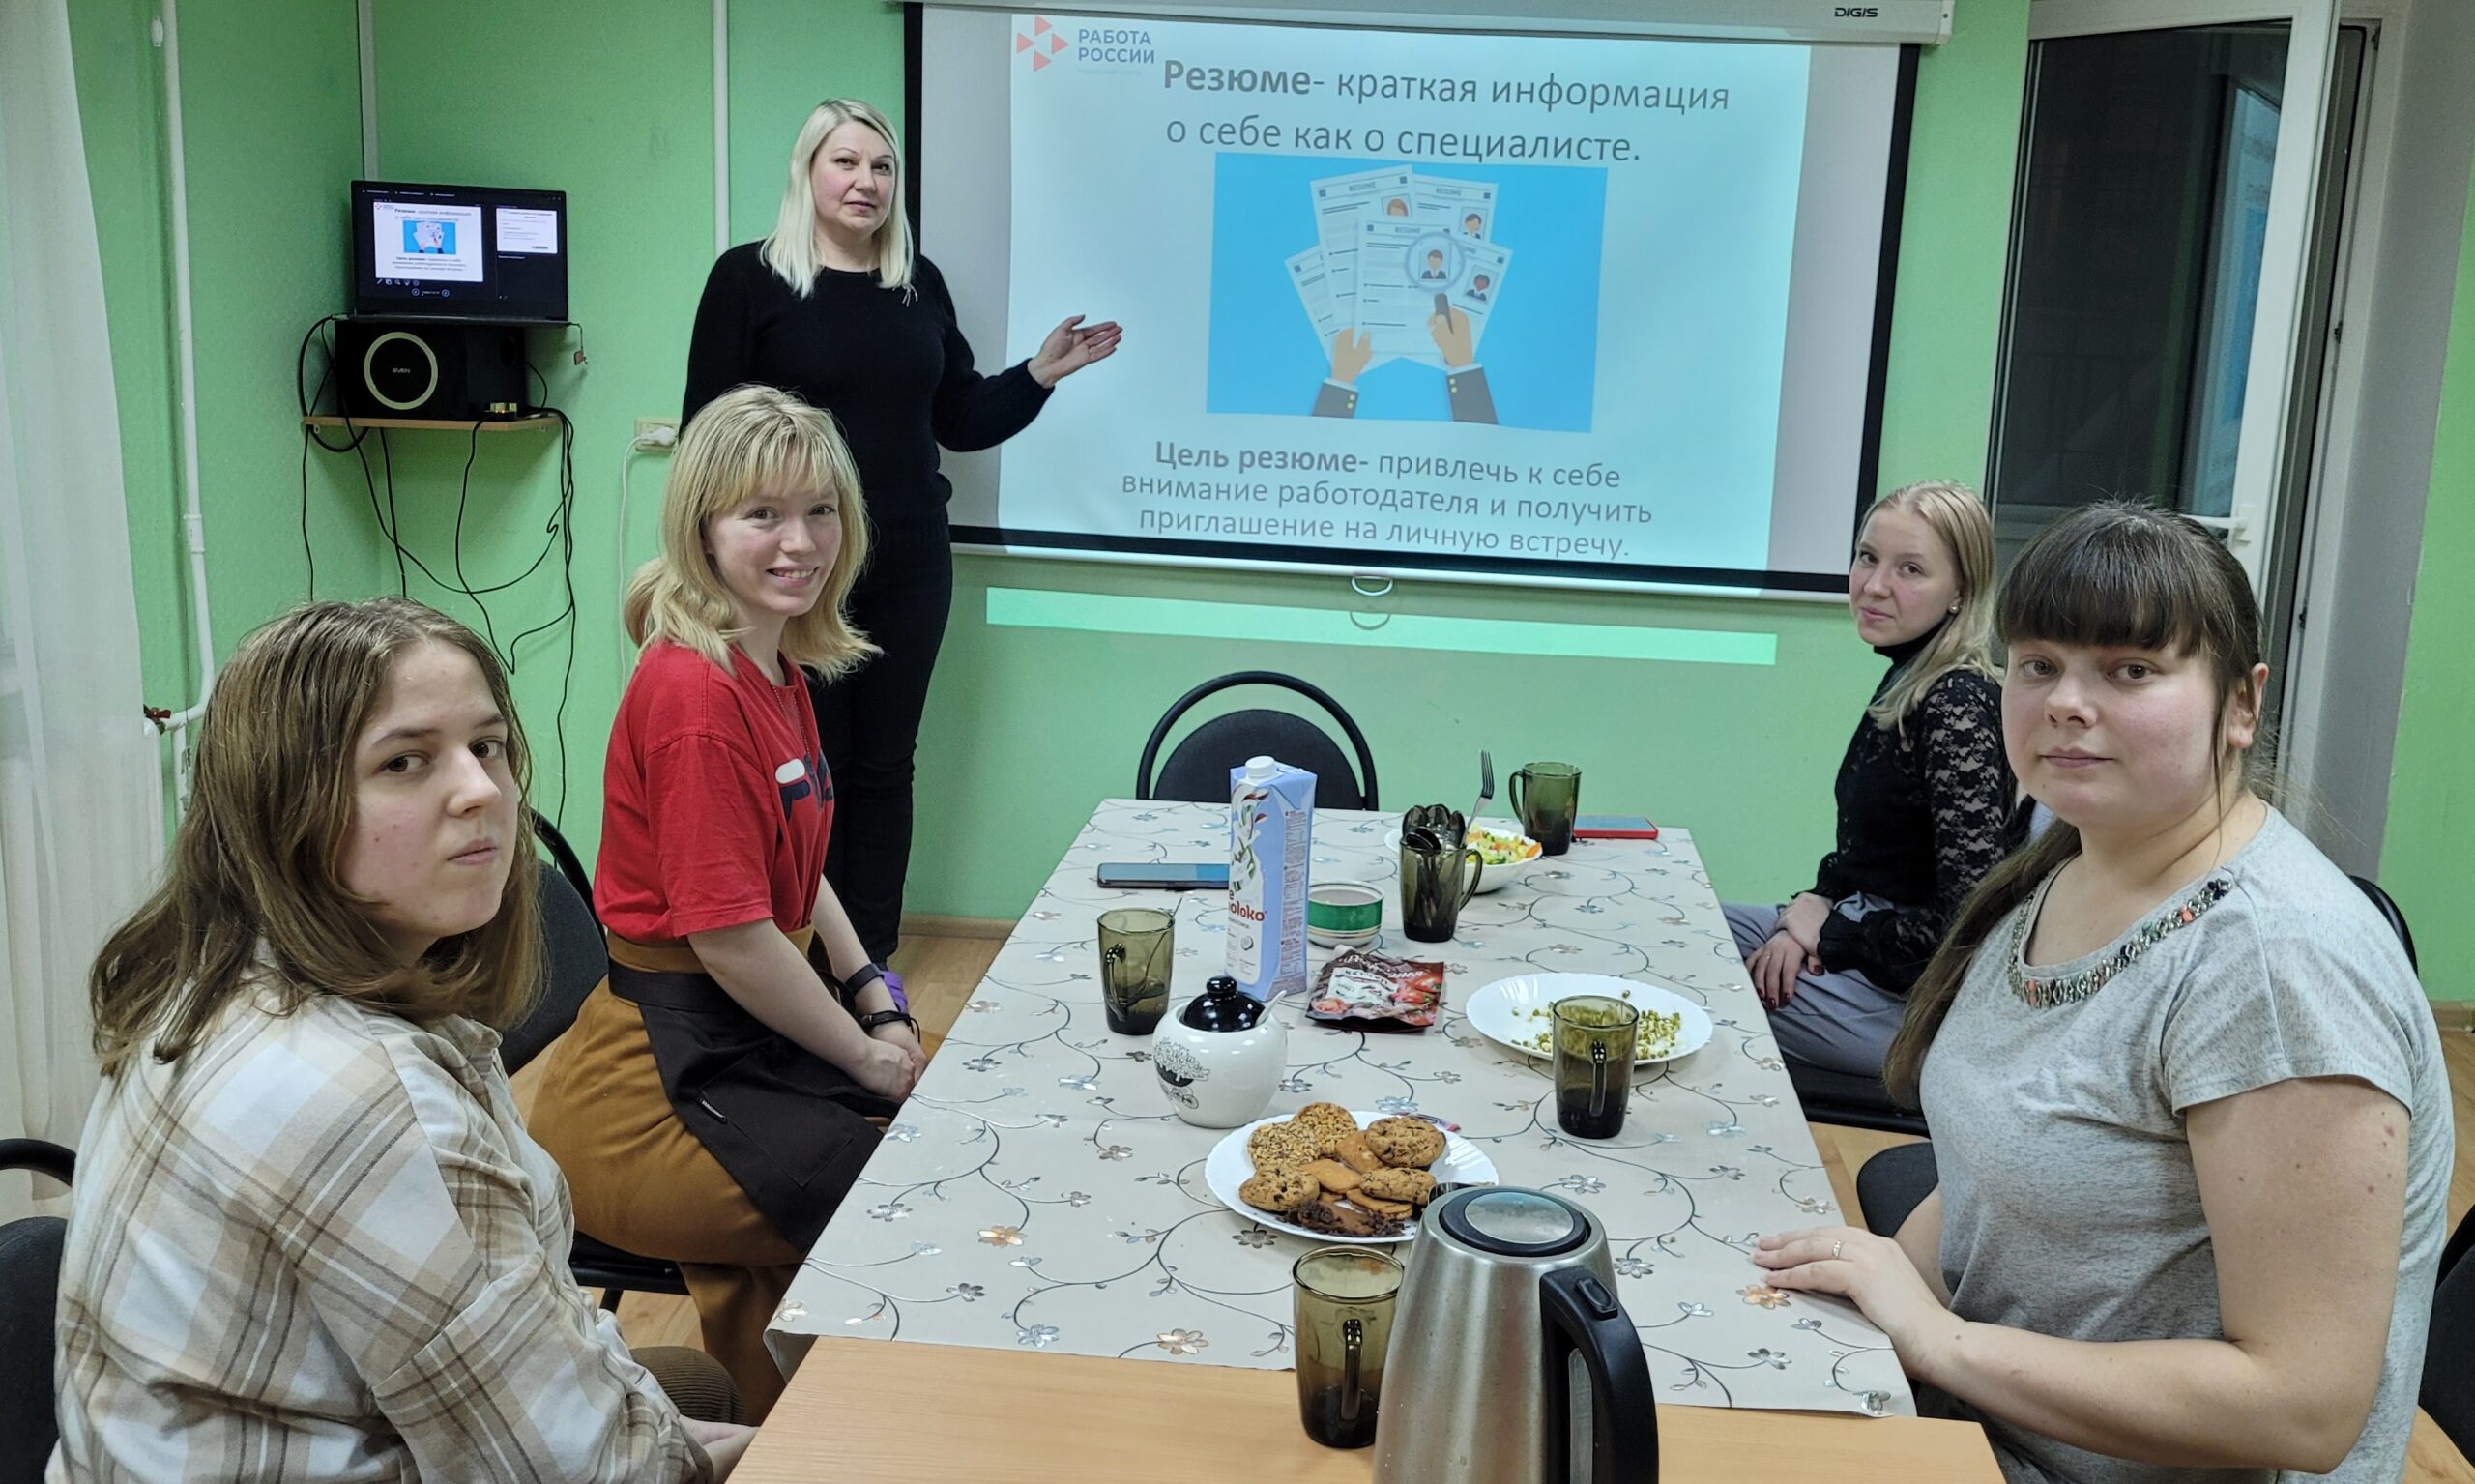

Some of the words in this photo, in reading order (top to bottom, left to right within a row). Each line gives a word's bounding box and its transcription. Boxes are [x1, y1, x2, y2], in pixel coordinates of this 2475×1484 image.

[1834, 7, 1878, 17] DIGIS
[1079, 30, 1150, 44] РАБОТА
[1079, 47, 1154, 64] РОССИИ
[1165, 60, 1325, 95] Резюме-
[1338, 74, 1476, 104] краткая
[1492, 73, 1730, 115] информация
[1167, 121, 1186, 143] о
[1200, 114, 1281, 147] себе
[1296, 127, 1352, 150] как
[1365, 129, 1384, 152] о
[1397, 130, 1640, 162] специалисте.
[1156, 441, 1229, 470] Цель
[1239, 451, 1368, 474] резюме-
[1380, 455, 1518, 482] привлечь
[1529, 467, 1542, 484] к
[1553, 463, 1619, 487] себе
[1122, 476, 1267, 501] внимание
[1279, 480, 1478, 514] работодателя
[1491, 499, 1505, 516] и
[1518, 500, 1652, 526] получить
[1141, 510, 1333, 537] приглашение
[1346, 521, 1376, 538] на
[1386, 524, 1499, 552] личную
[1511, 535, 1629, 561] встречу.
[1229, 901, 1266, 921] oloko
